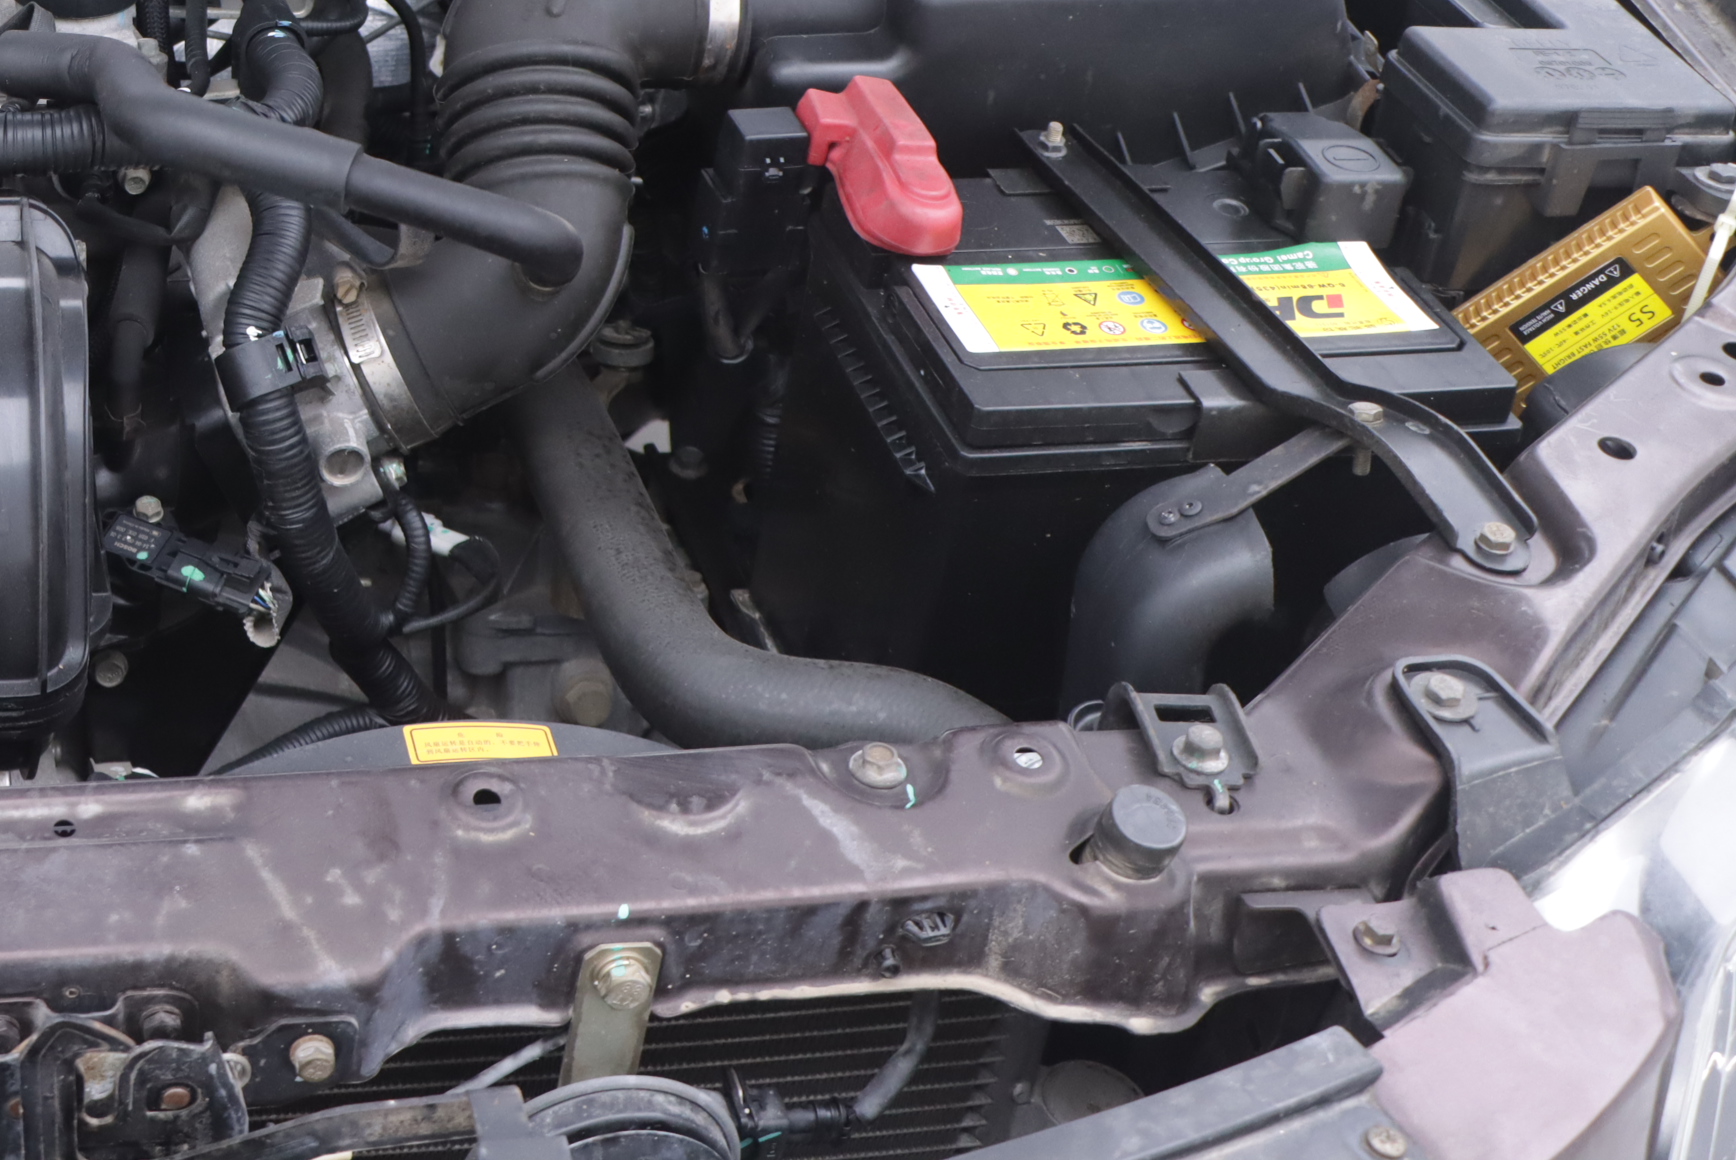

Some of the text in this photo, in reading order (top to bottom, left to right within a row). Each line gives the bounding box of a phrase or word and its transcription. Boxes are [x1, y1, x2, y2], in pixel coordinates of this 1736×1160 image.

[1238, 255, 1274, 264] Group
[1276, 250, 1313, 262] Camel
[1569, 273, 1607, 301] DANGER
[1627, 303, 1656, 330] S5
[1522, 312, 1555, 336] HIGH VOLTAGE
[1605, 322, 1620, 334] 12V
[1591, 330, 1608, 344] 55W
[1575, 340, 1592, 355] FAST
[1551, 350, 1576, 370] BRIGHT
[114, 541, 138, 553] BOSCH
